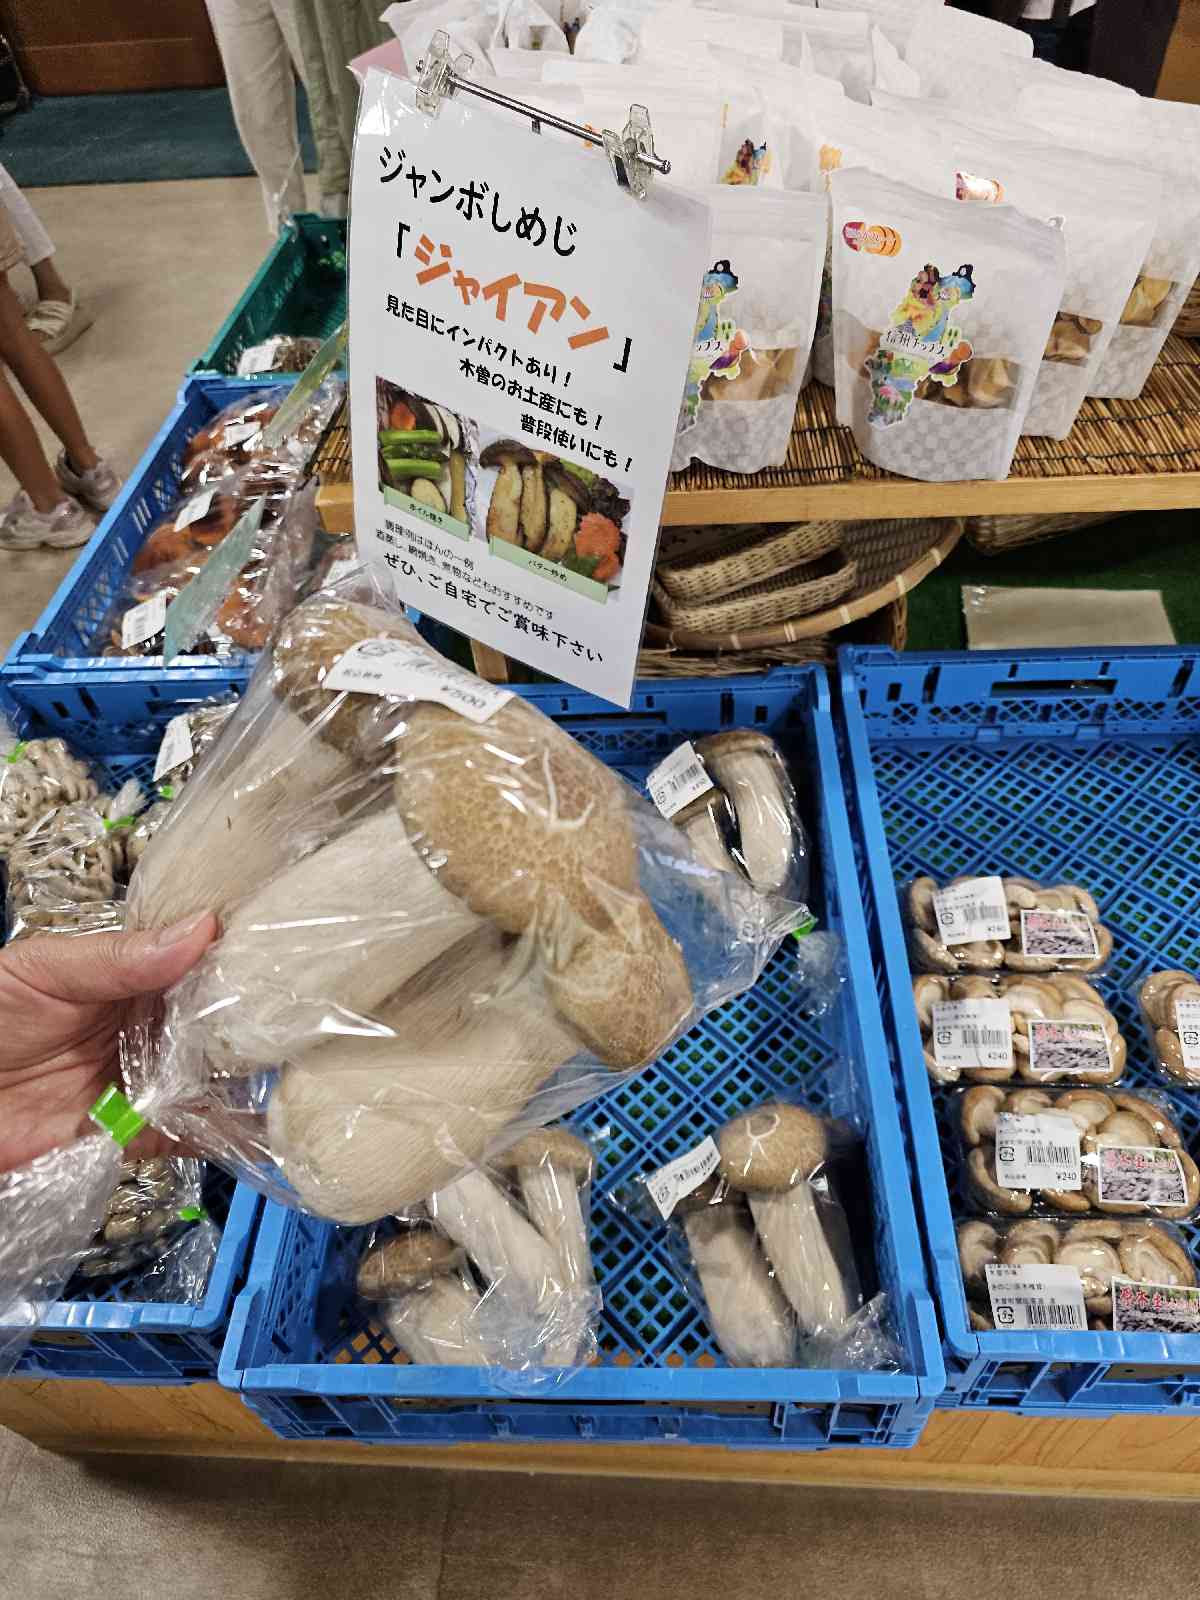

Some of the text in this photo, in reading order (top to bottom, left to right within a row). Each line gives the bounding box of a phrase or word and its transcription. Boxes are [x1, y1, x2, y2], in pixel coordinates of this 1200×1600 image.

[379, 146, 578, 257] ジャンボしめじ
[385, 293, 573, 388] 見た目にインパクトあり！
[396, 221, 633, 373] 「ジャイアン」
[459, 356, 605, 432] 木曽のお土産にも！
[519, 412, 635, 474] 普段使いにも！
[383, 551, 605, 665] ぜひ、ご自宅でご賞味下さい
[1056, 1171, 1078, 1181] ¥240
